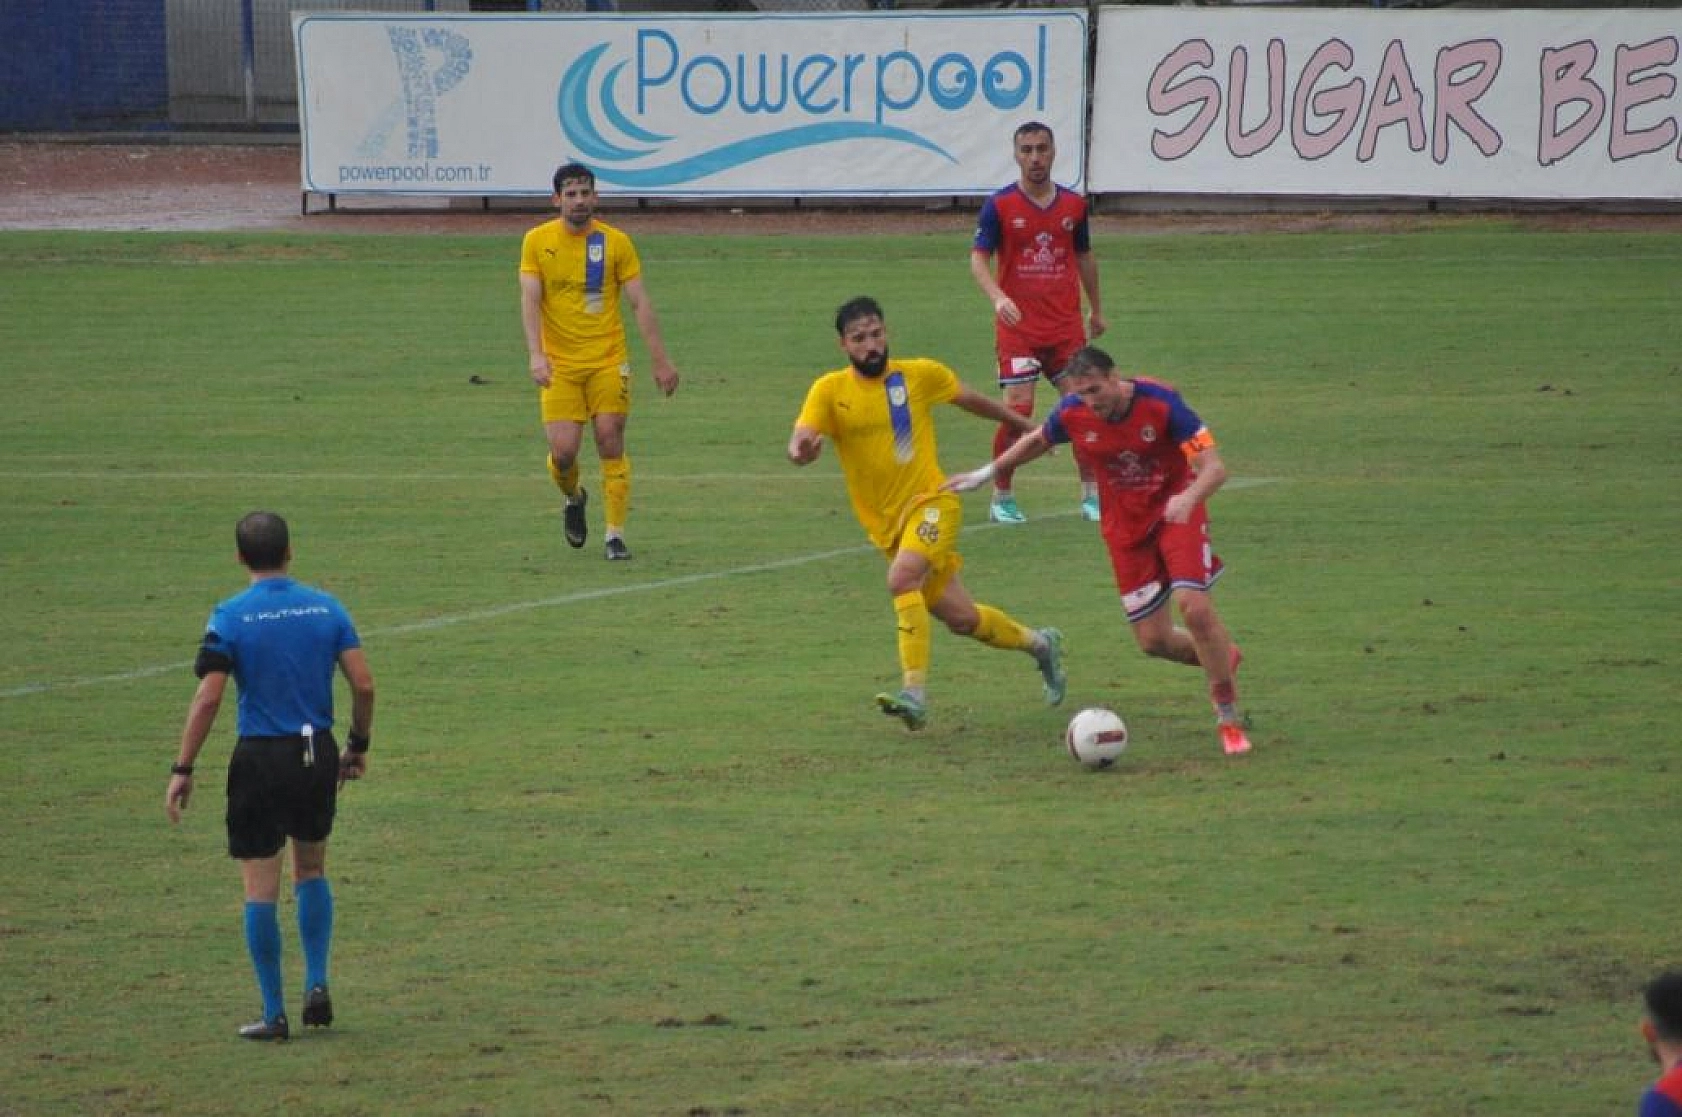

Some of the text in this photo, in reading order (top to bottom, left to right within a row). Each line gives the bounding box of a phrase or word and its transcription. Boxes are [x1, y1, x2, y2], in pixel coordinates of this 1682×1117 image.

[636, 25, 1046, 123] Powerpool
[1147, 36, 1682, 166] SUGAR BE
[338, 162, 492, 183] powerpool.com.tr
